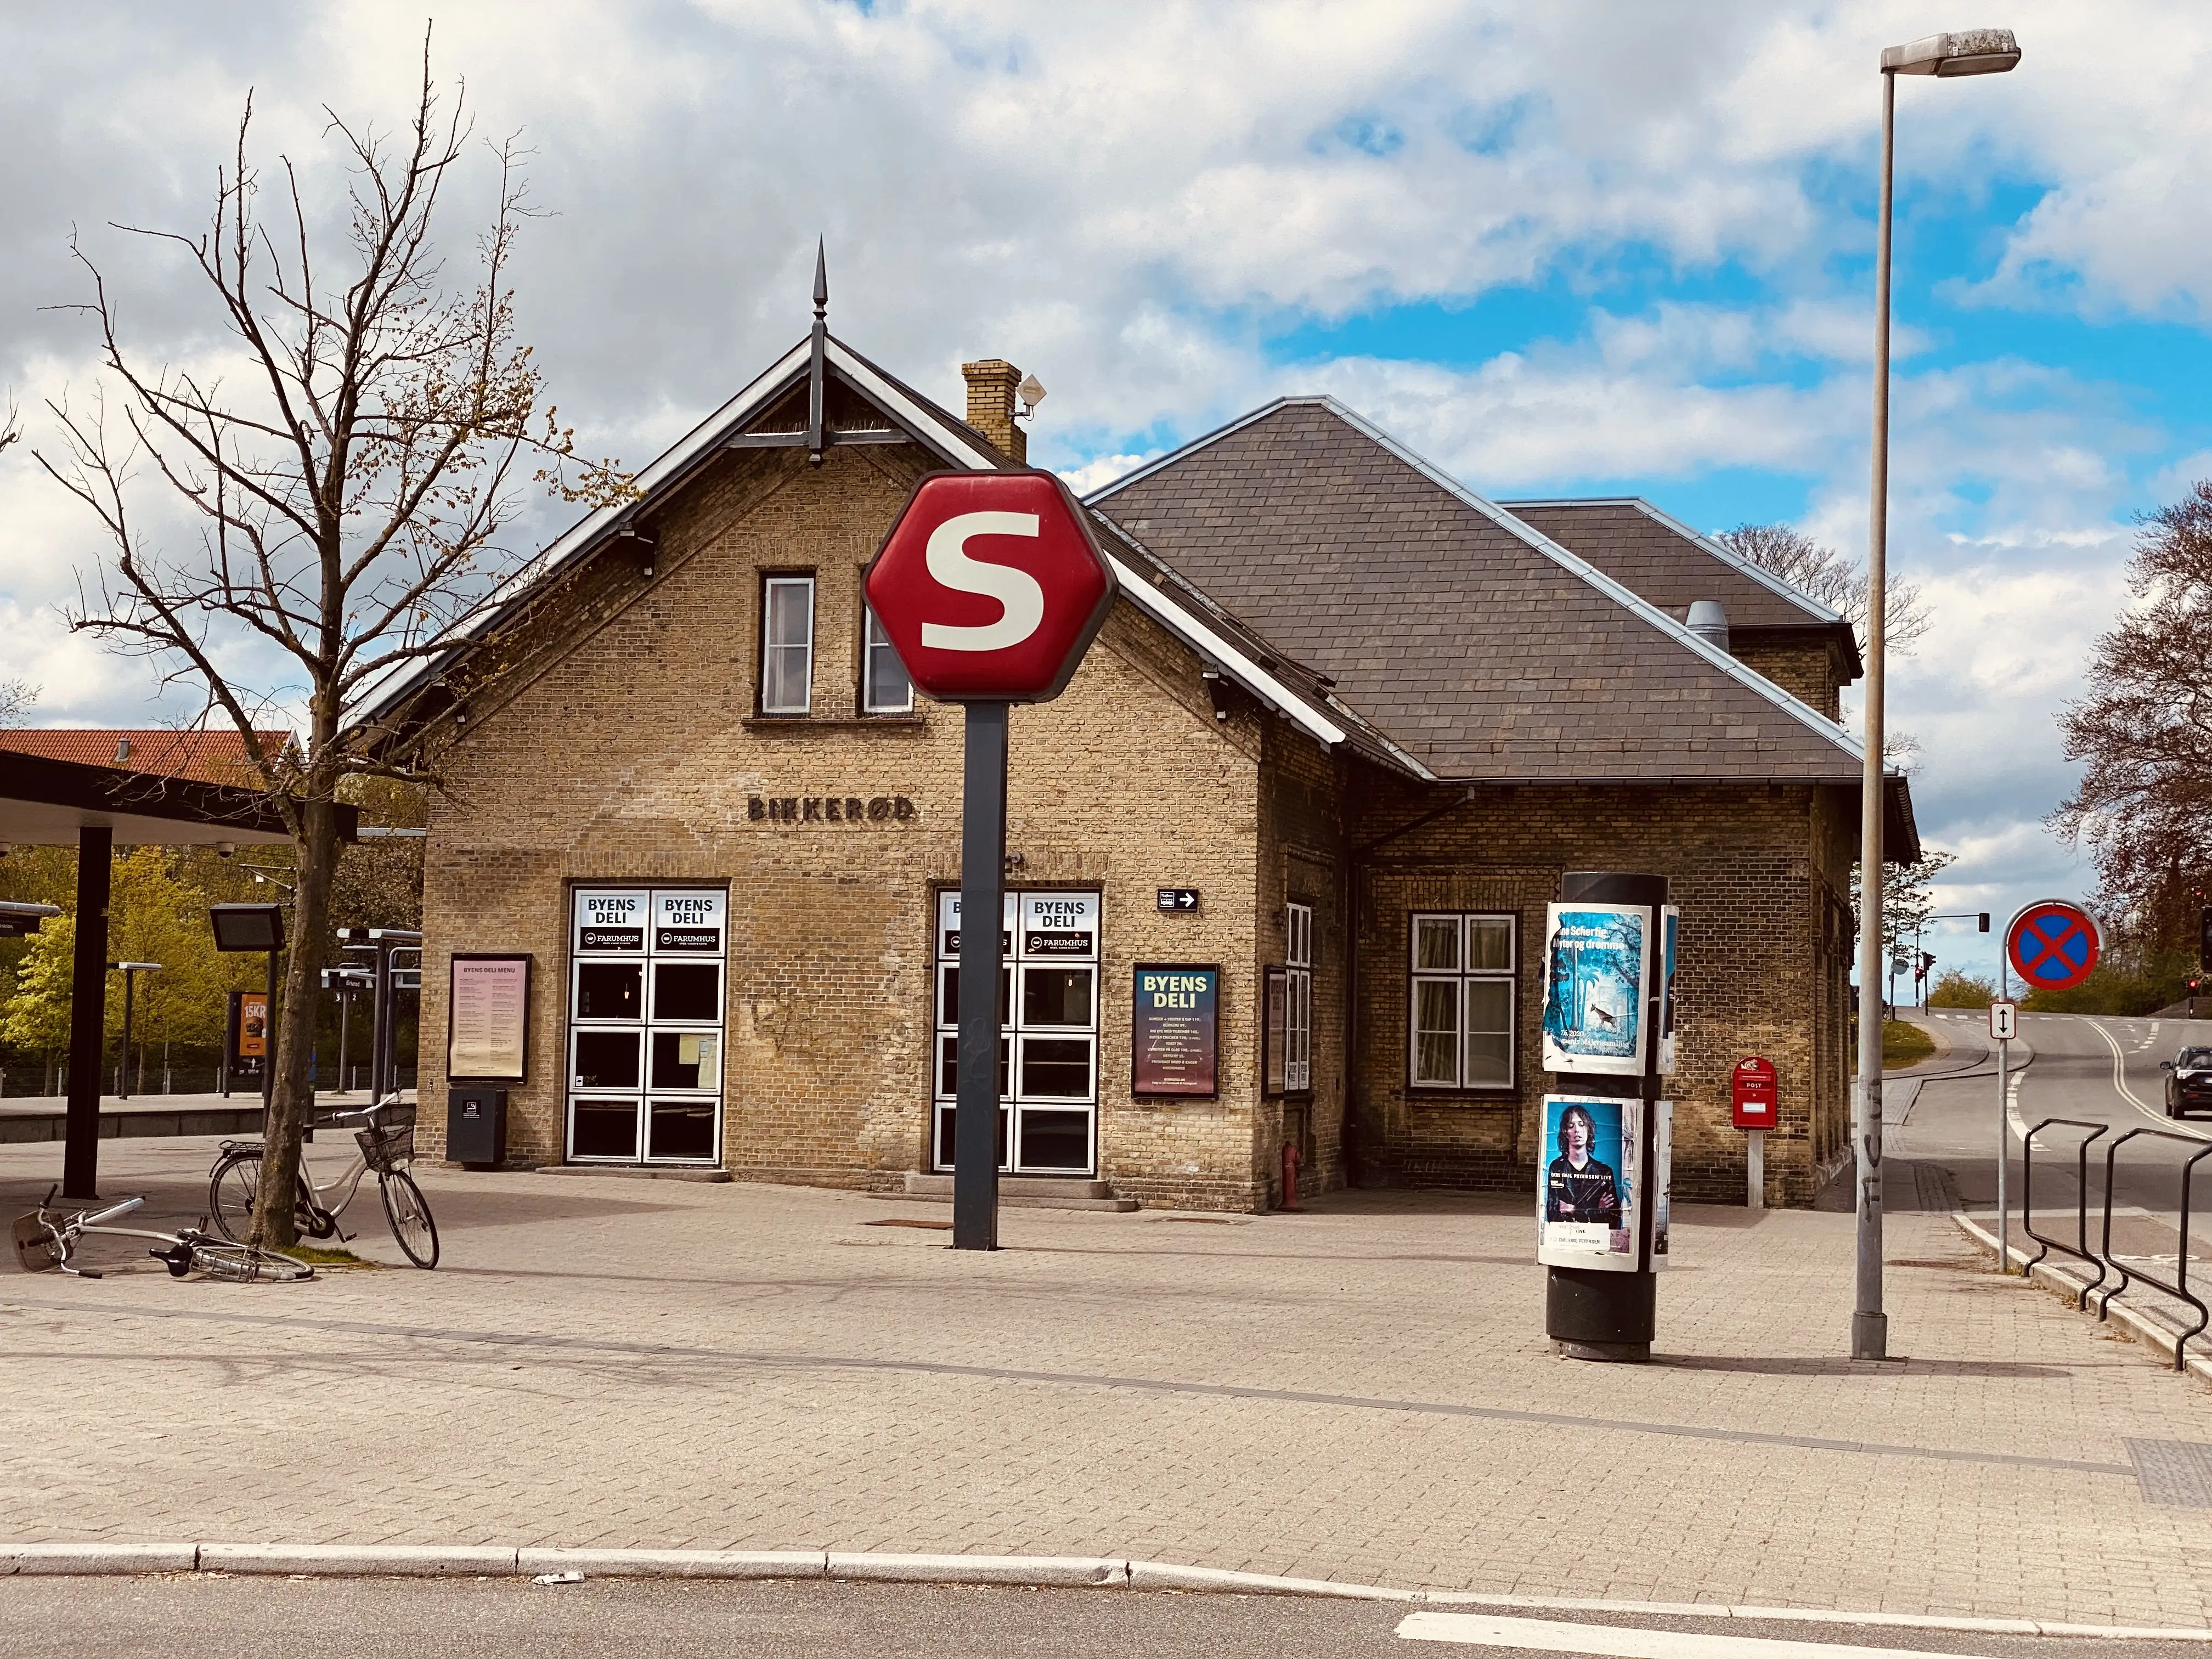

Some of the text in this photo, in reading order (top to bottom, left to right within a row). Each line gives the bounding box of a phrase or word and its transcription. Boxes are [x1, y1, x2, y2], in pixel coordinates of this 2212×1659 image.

[921, 511, 1044, 651] S
[748, 796, 913, 820] BIRKERØD
[588, 899, 636, 911] BYENS
[665, 899, 713, 912] BYENS
[1035, 902, 1085, 915] BYENS
[595, 912, 627, 924] DELI
[672, 913, 704, 924] DELI
[1042, 916, 1075, 928] DELI
[1553, 938, 1624, 951] Myter og drømme
[1144, 976, 1207, 992] BYENS
[1154, 993, 1195, 1008] DELI
[245, 1005, 266, 1018] 15KR
